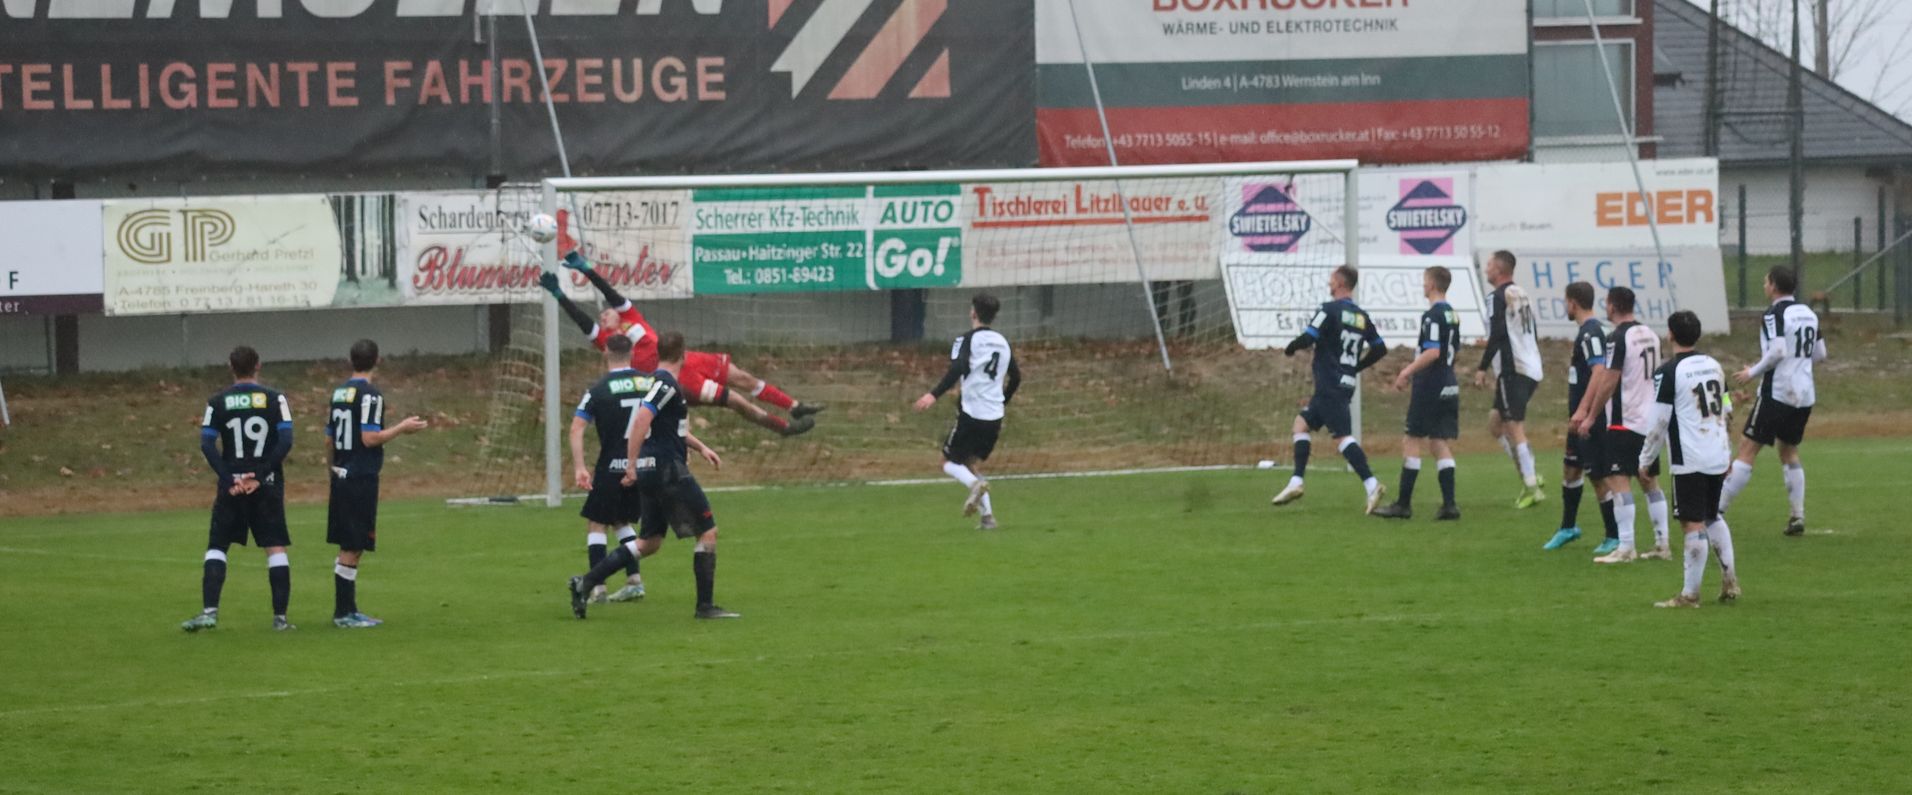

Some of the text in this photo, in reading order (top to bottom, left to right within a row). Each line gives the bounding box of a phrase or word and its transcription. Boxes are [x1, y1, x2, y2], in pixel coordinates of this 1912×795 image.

[1163, 18, 1399, 36] WÄRME- UND ELEKTROTECHNIK
[384, 57, 727, 105] FAHRZEUGE
[1181, 71, 1382, 90] Linden 4 A-4783 Wernstein am Inn
[583, 201, 680, 227] 07713-7017
[695, 204, 860, 230] Scherrer Kfz-Technik
[880, 200, 954, 224] AUTO
[973, 187, 1068, 217] Tischlerei
[1596, 189, 1714, 227] EDER
[1232, 213, 1308, 233] SWIETELSKY
[1388, 209, 1466, 228] SWIETELSKY
[117, 208, 235, 264] GP
[821, 243, 843, 258] Str.
[847, 242, 864, 258] 22
[413, 246, 541, 292] Blumen
[875, 237, 952, 278] Go!
[724, 268, 751, 285] Tel.:
[1794, 325, 1816, 358] 18
[984, 351, 1000, 381] 4
[1639, 346, 1656, 381] 17
[1692, 379, 1723, 418] 13
[225, 416, 269, 459] 19
[332, 408, 353, 450] 21
